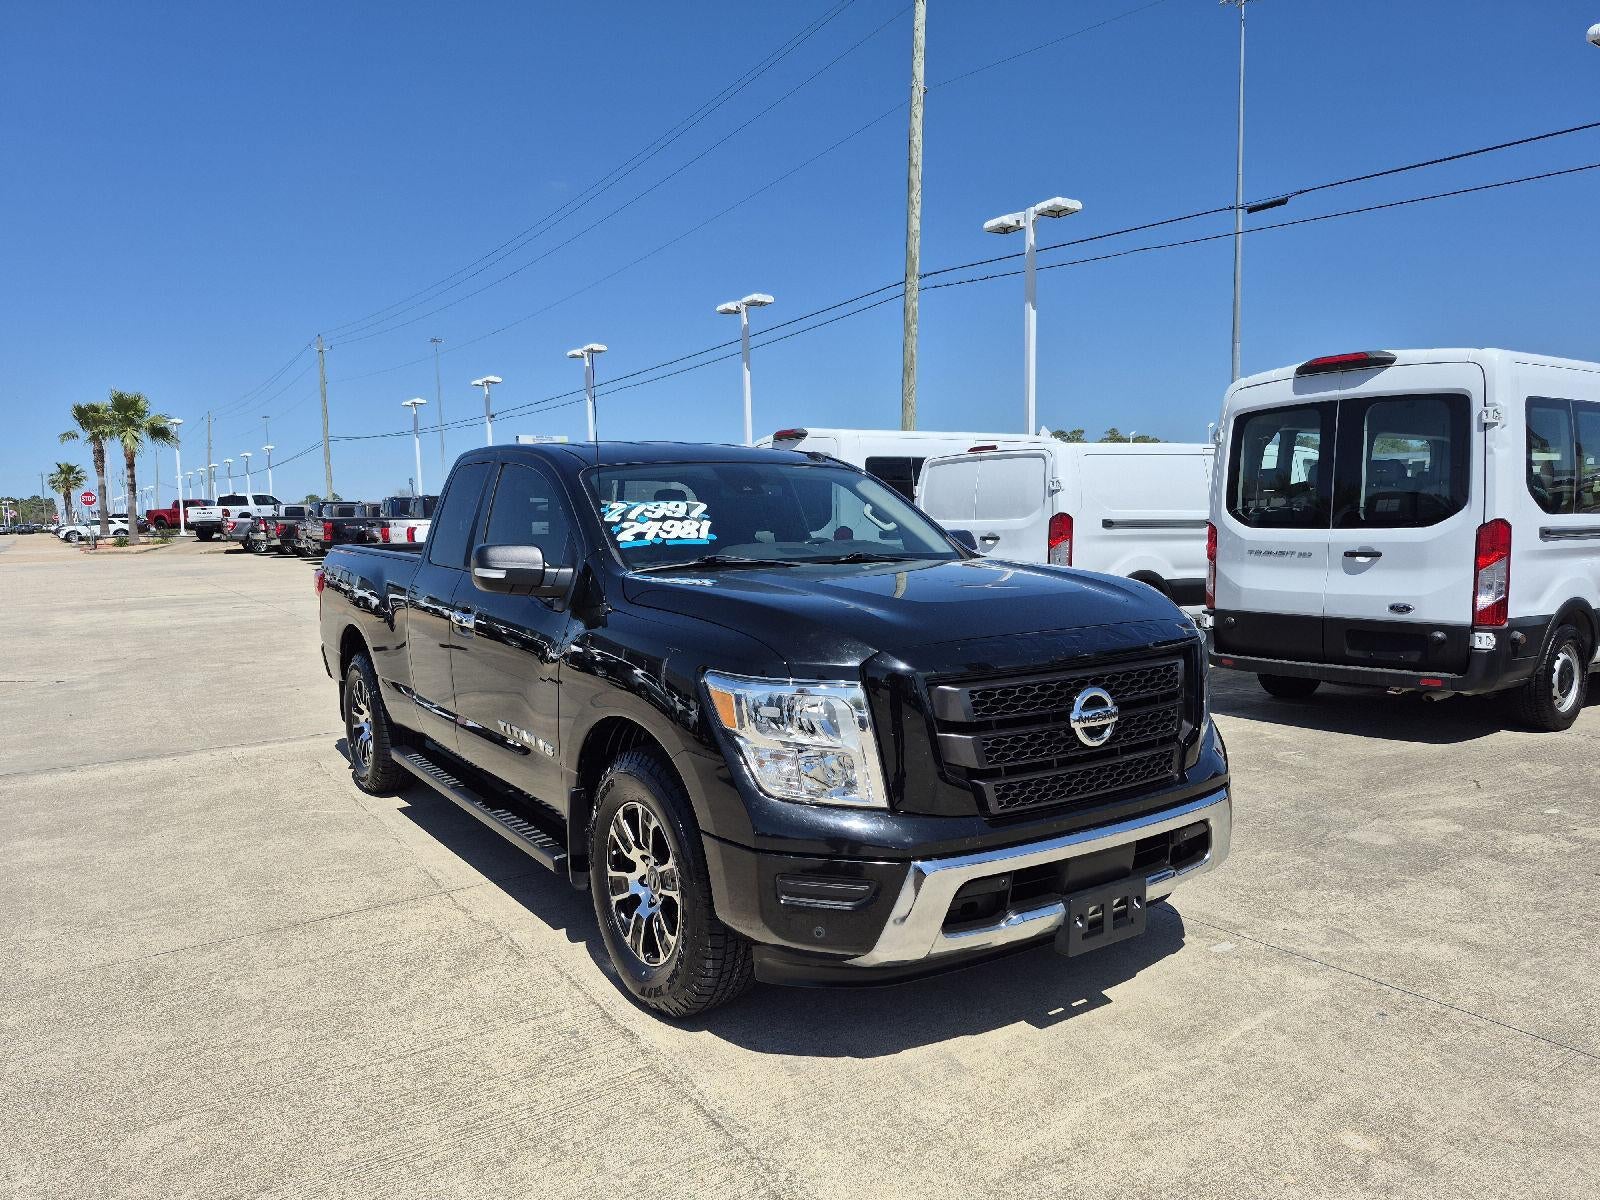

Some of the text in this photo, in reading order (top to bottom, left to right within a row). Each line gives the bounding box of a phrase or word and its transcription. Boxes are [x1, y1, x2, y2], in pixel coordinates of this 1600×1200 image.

[1247, 549, 1296, 558] TRANSIT
[1079, 709, 1117, 723] NISSAN
[498, 719, 536, 747] TITAN
